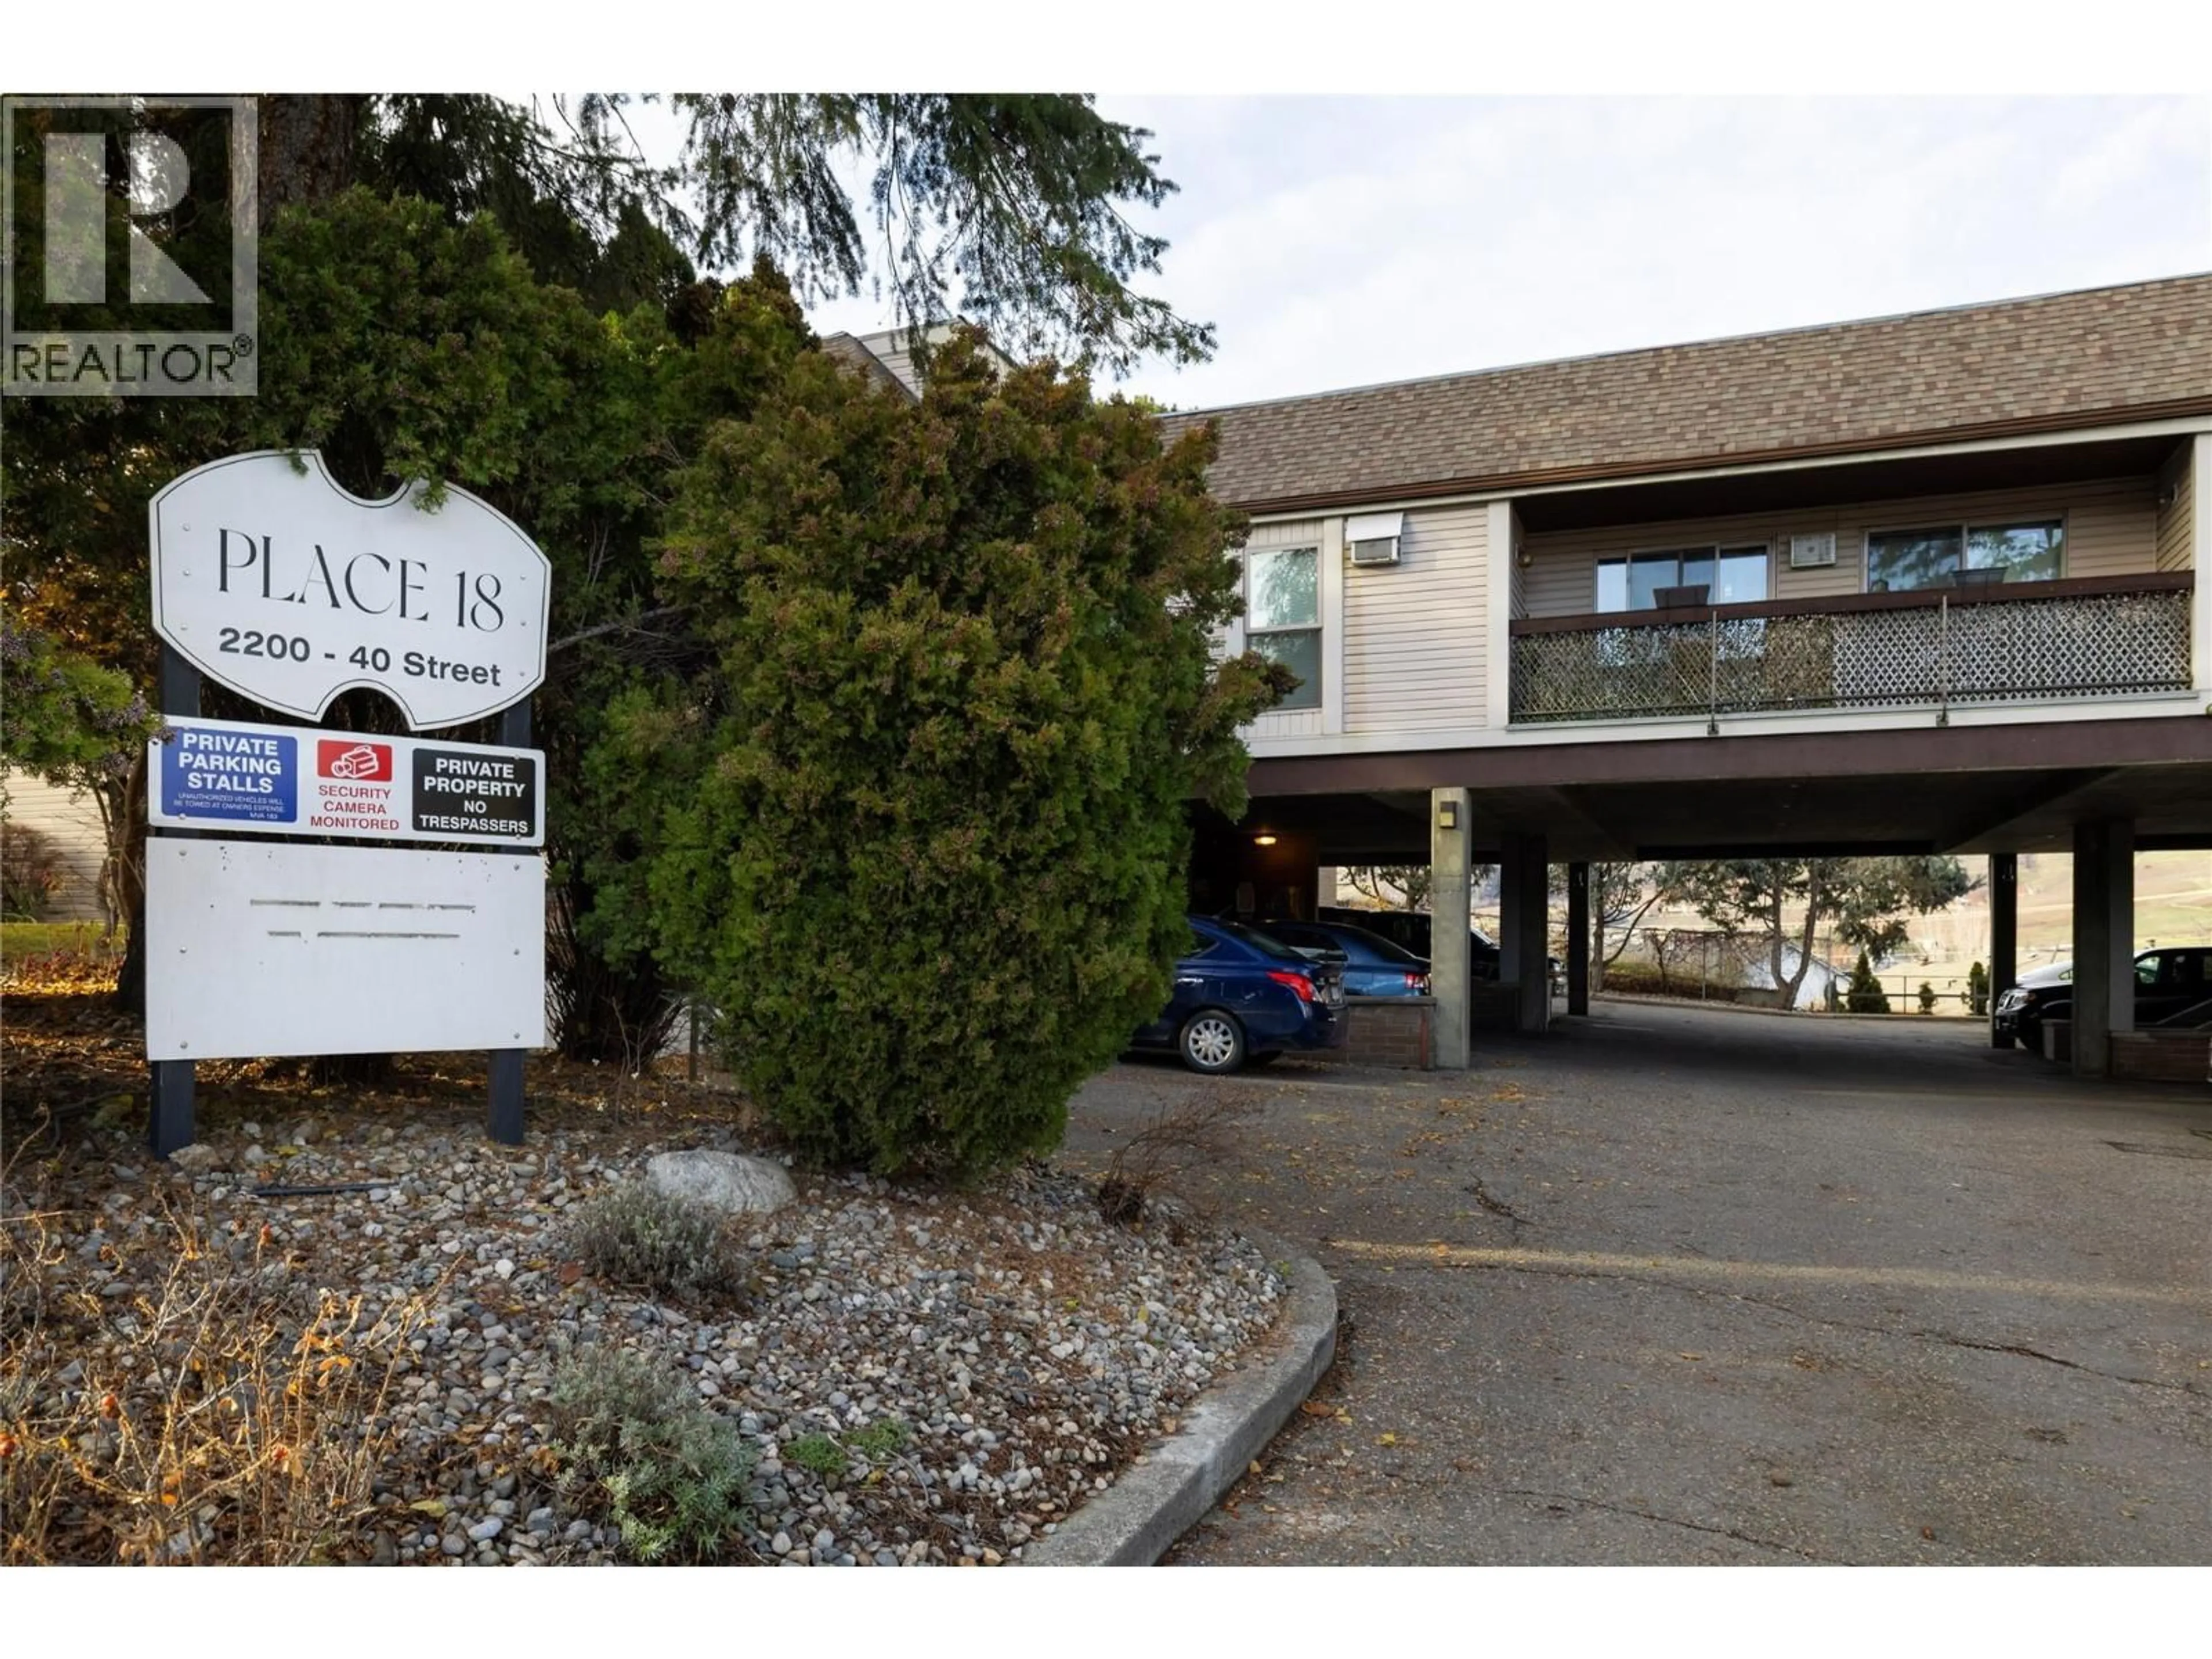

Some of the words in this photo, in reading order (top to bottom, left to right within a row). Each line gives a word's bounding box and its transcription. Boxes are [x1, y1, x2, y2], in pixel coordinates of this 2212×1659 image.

[219, 528, 429, 622] PLACE
[455, 570, 504, 632] 18
[219, 627, 311, 662] 2200
[349, 646, 391, 672] 40
[403, 652, 501, 687] Street
[183, 733, 278, 756] PRIVATE
[178, 752, 282, 775] PARKING
[435, 757, 514, 778] PRIVATE
[187, 772, 274, 794] STALLS
[319, 785, 391, 800] SECURITY
[423, 776, 525, 798] PROPERTY
[324, 801, 387, 815] CAMERA
[464, 800, 487, 813] NO
[310, 816, 399, 831] MONITORED
[419, 814, 528, 834] TRESPASSERS
